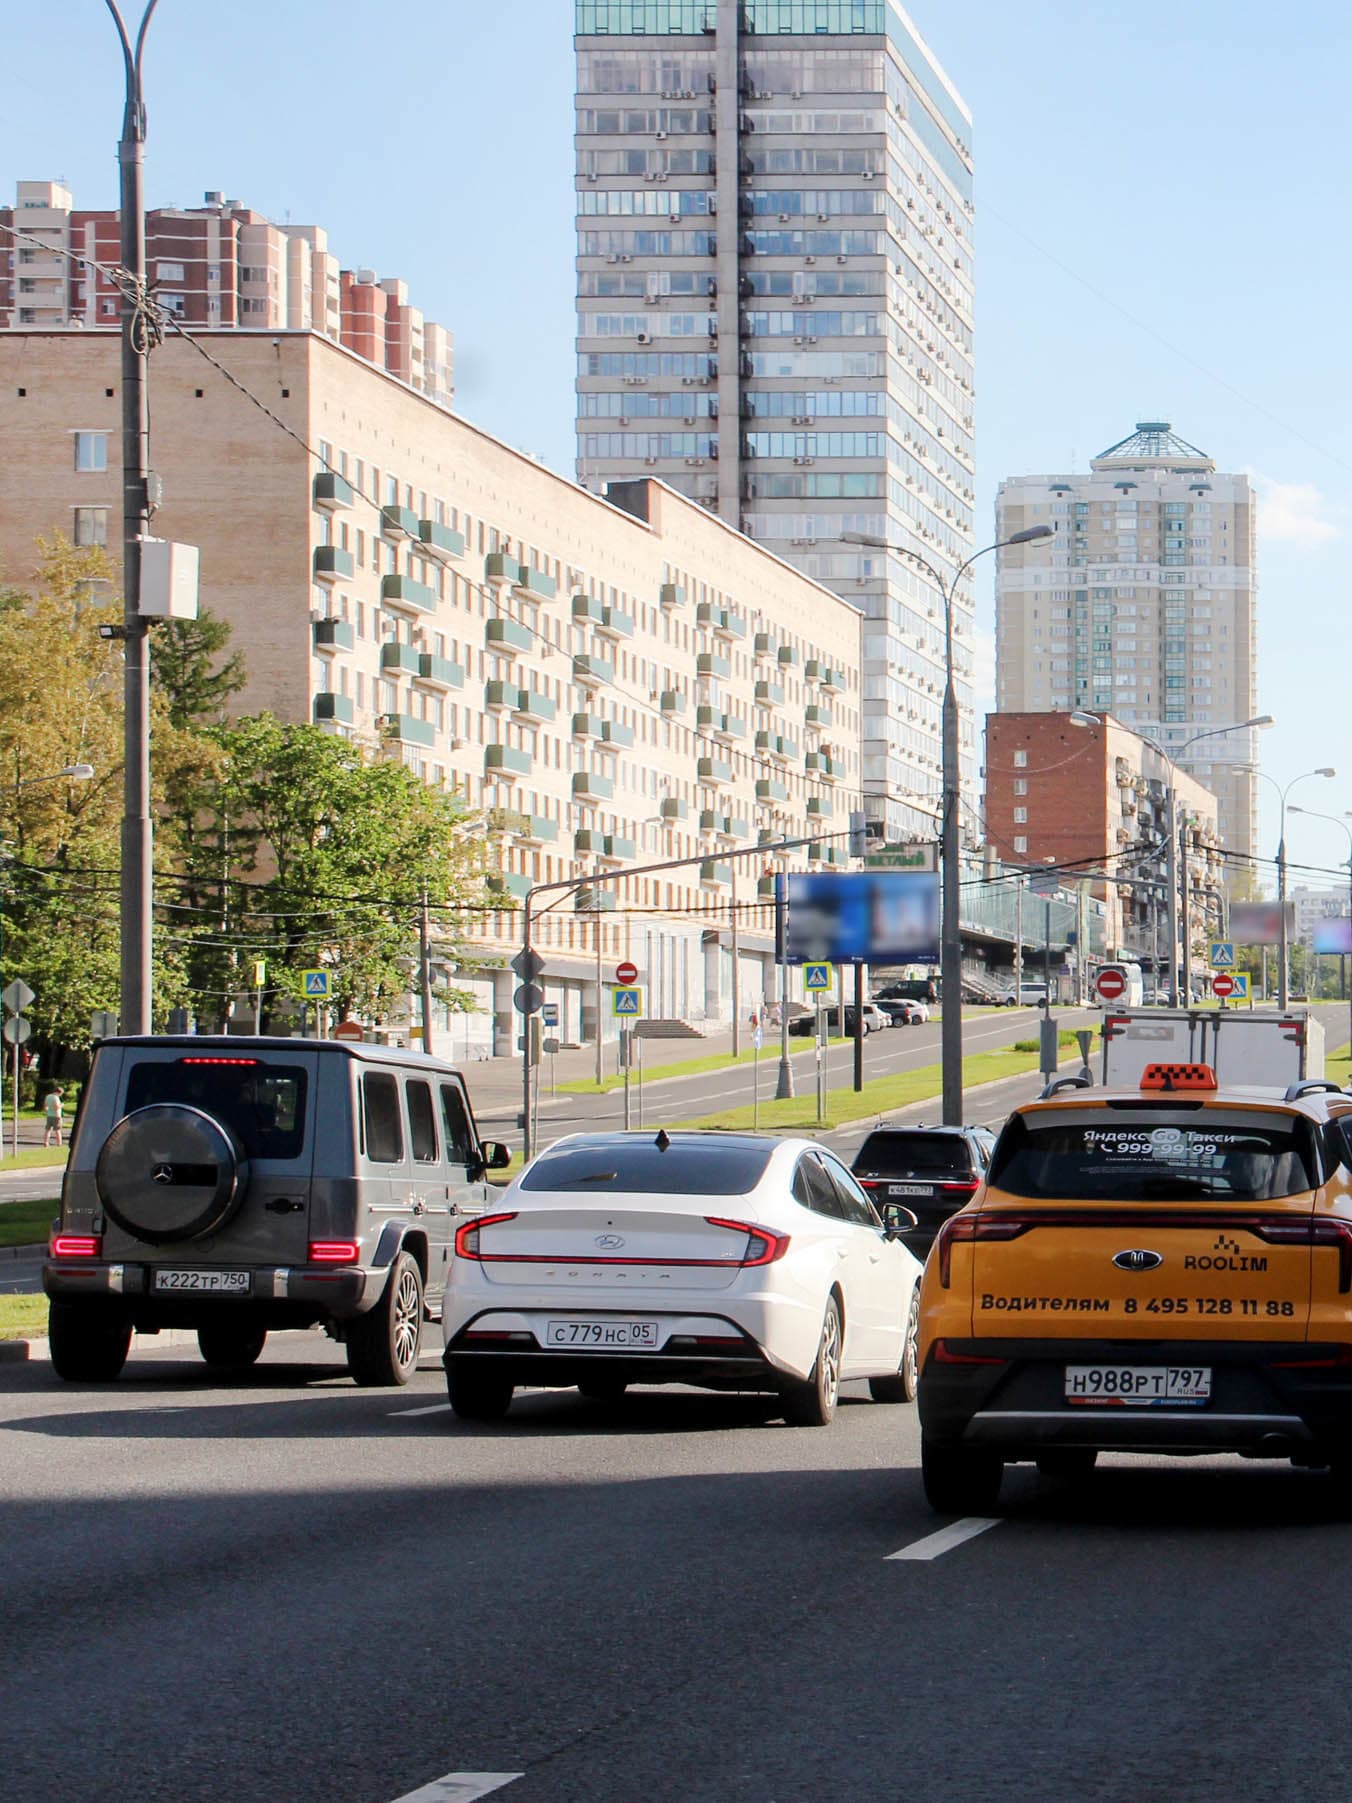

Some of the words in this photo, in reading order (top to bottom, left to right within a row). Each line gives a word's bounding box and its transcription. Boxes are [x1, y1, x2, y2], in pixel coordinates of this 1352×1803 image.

[1083, 1130, 1147, 1142] Яндекс
[1152, 1129, 1179, 1143] Go
[1185, 1131, 1235, 1143] Такси
[1117, 1143, 1217, 1155] 999-99-99
[1184, 1255, 1268, 1271] ROOLIM
[160, 1273, 219, 1288] К222ТР
[223, 1273, 245, 1285] 750
[981, 1294, 1110, 1312] Водителям
[1124, 1299, 1138, 1314] 8
[1145, 1298, 1189, 1314] 495
[1196, 1299, 1232, 1314] 128
[1241, 1299, 1258, 1315] 11
[1265, 1300, 1295, 1316] 88
[555, 1324, 627, 1343] С779НС
[632, 1325, 650, 1338] 05
[1073, 1370, 1164, 1393] Н988РТ
[1169, 1370, 1203, 1387] 797
